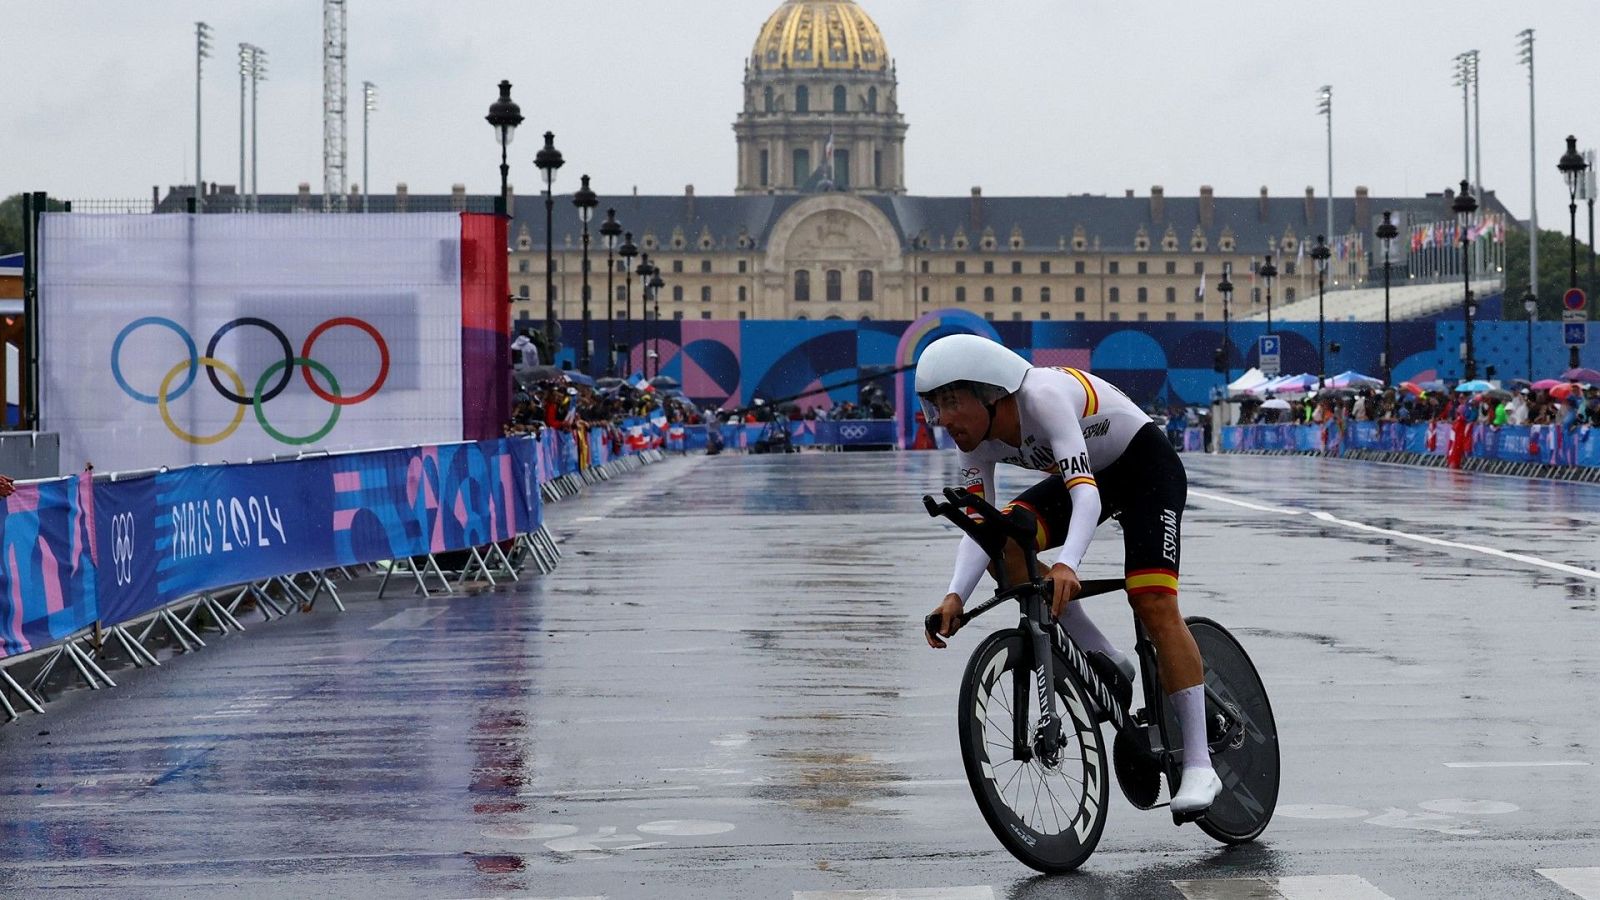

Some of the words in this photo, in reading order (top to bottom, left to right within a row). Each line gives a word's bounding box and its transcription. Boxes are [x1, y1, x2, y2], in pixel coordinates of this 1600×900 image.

[1059, 452, 1093, 478] PAÑ
[216, 495, 287, 550] 2024
[1160, 508, 1177, 564] ESPAÑA
[1036, 664, 1051, 727] CANYON
[1056, 622, 1124, 729] CANYON
